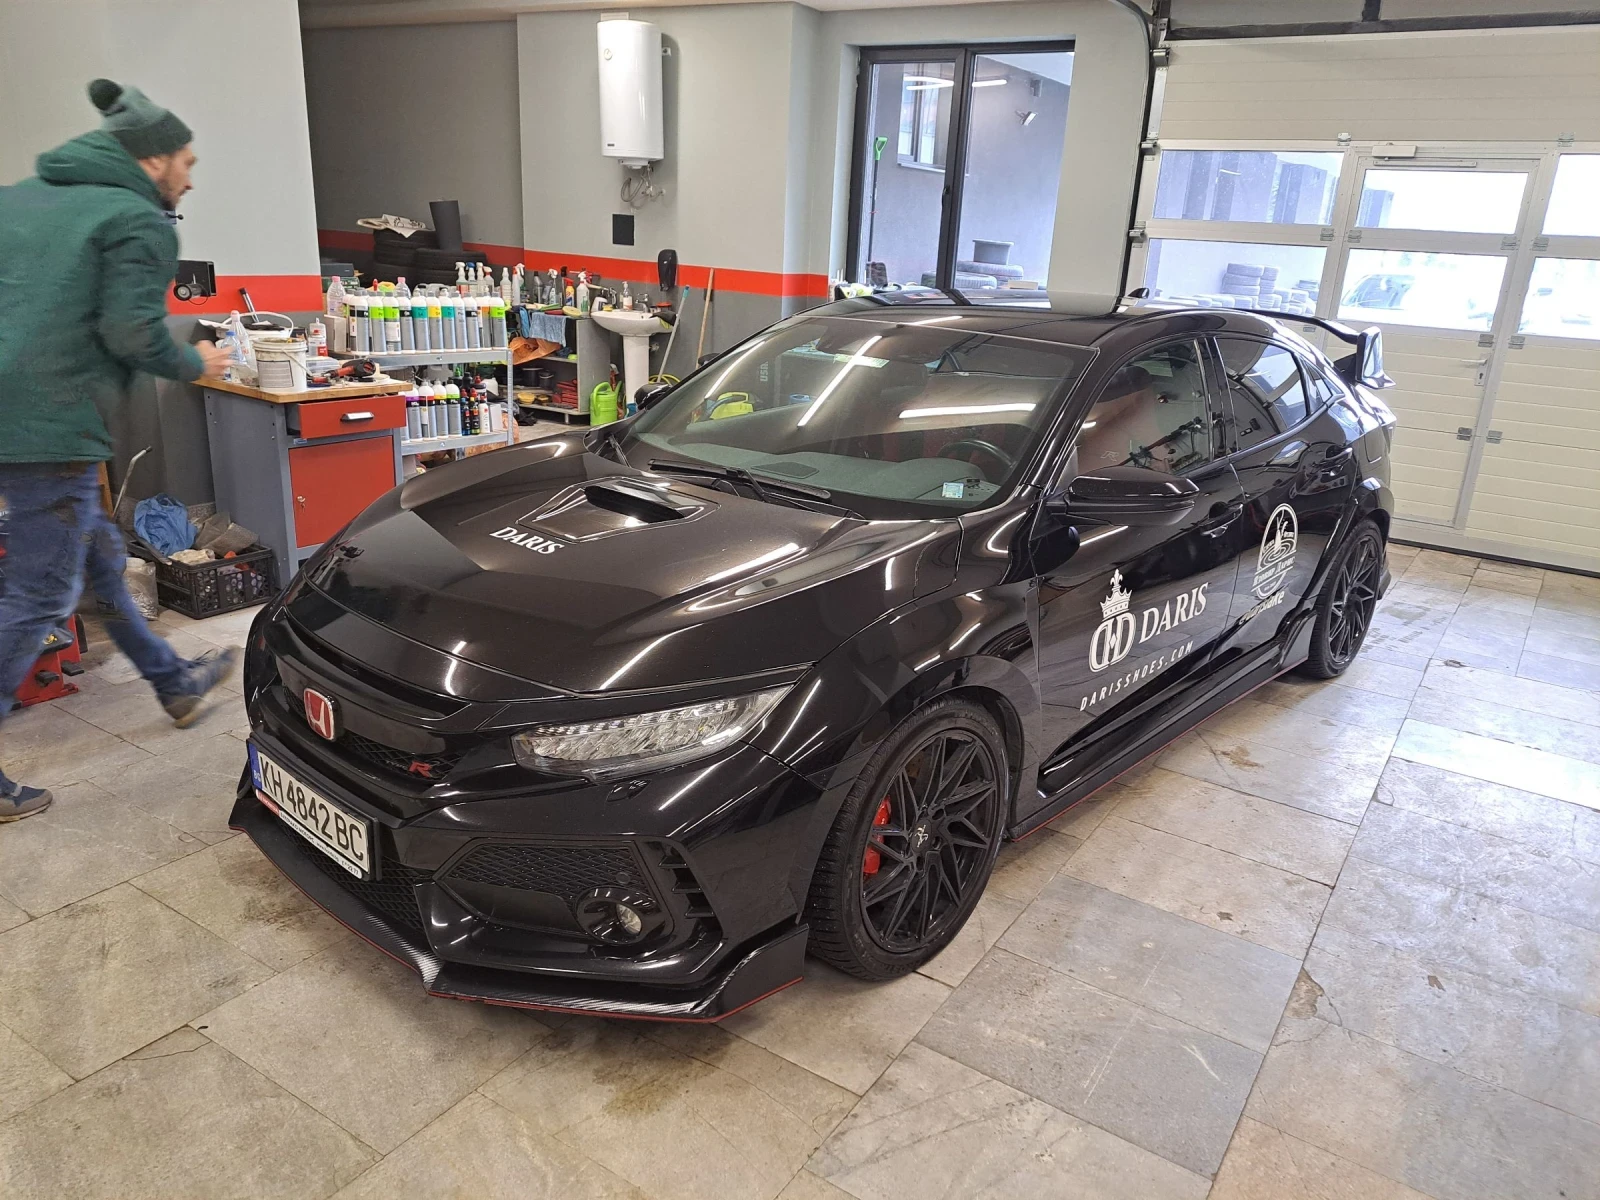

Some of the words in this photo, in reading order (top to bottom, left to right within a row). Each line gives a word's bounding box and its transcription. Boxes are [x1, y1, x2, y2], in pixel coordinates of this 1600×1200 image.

[489, 526, 565, 555] DARIS
[1138, 581, 1209, 644] DARIS
[1079, 640, 1194, 712] DARISSHOES.COM
[253, 768, 262, 782] BG
[259, 756, 285, 805] KH
[286, 779, 333, 842] 4842
[334, 815, 365, 863] BC
